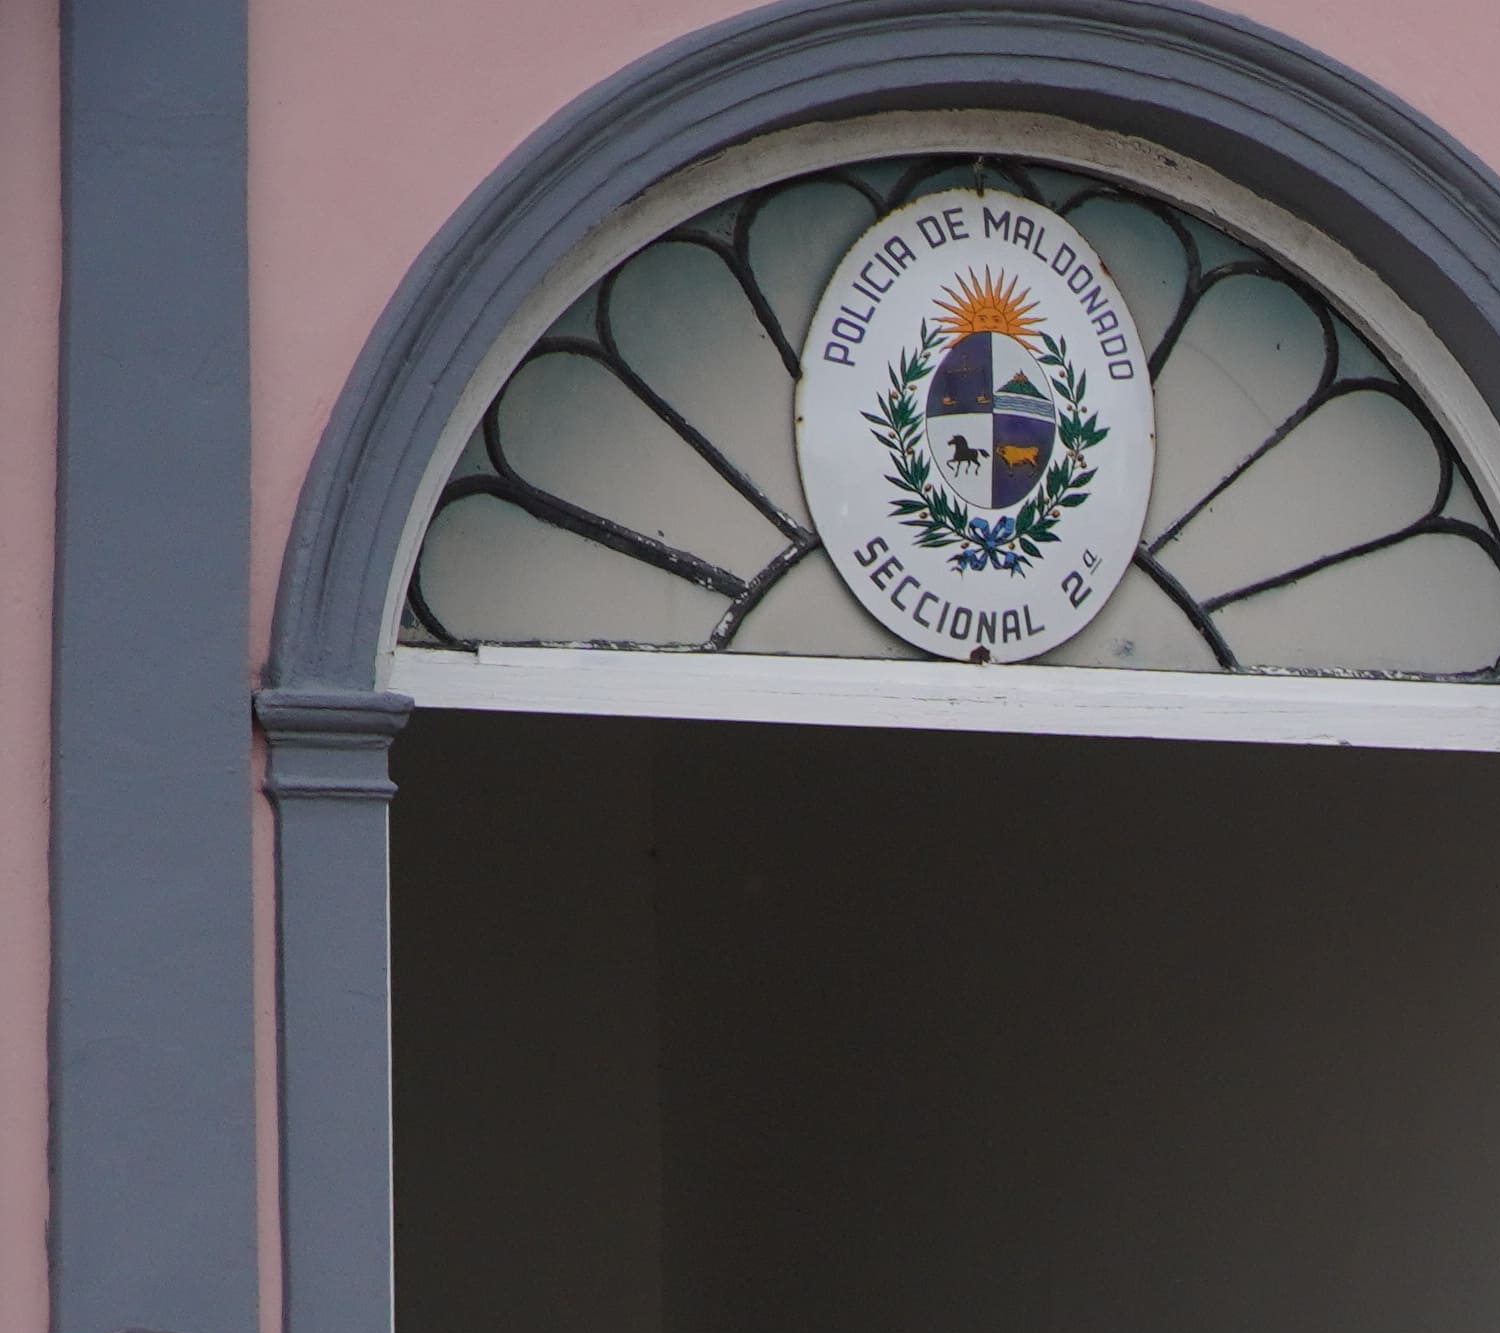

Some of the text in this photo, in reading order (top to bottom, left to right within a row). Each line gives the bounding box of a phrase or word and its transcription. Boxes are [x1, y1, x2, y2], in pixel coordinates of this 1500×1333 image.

[824, 206, 1135, 382] POLICIA DE MALDONADO
[853, 535, 1046, 645] SECCIONAL
